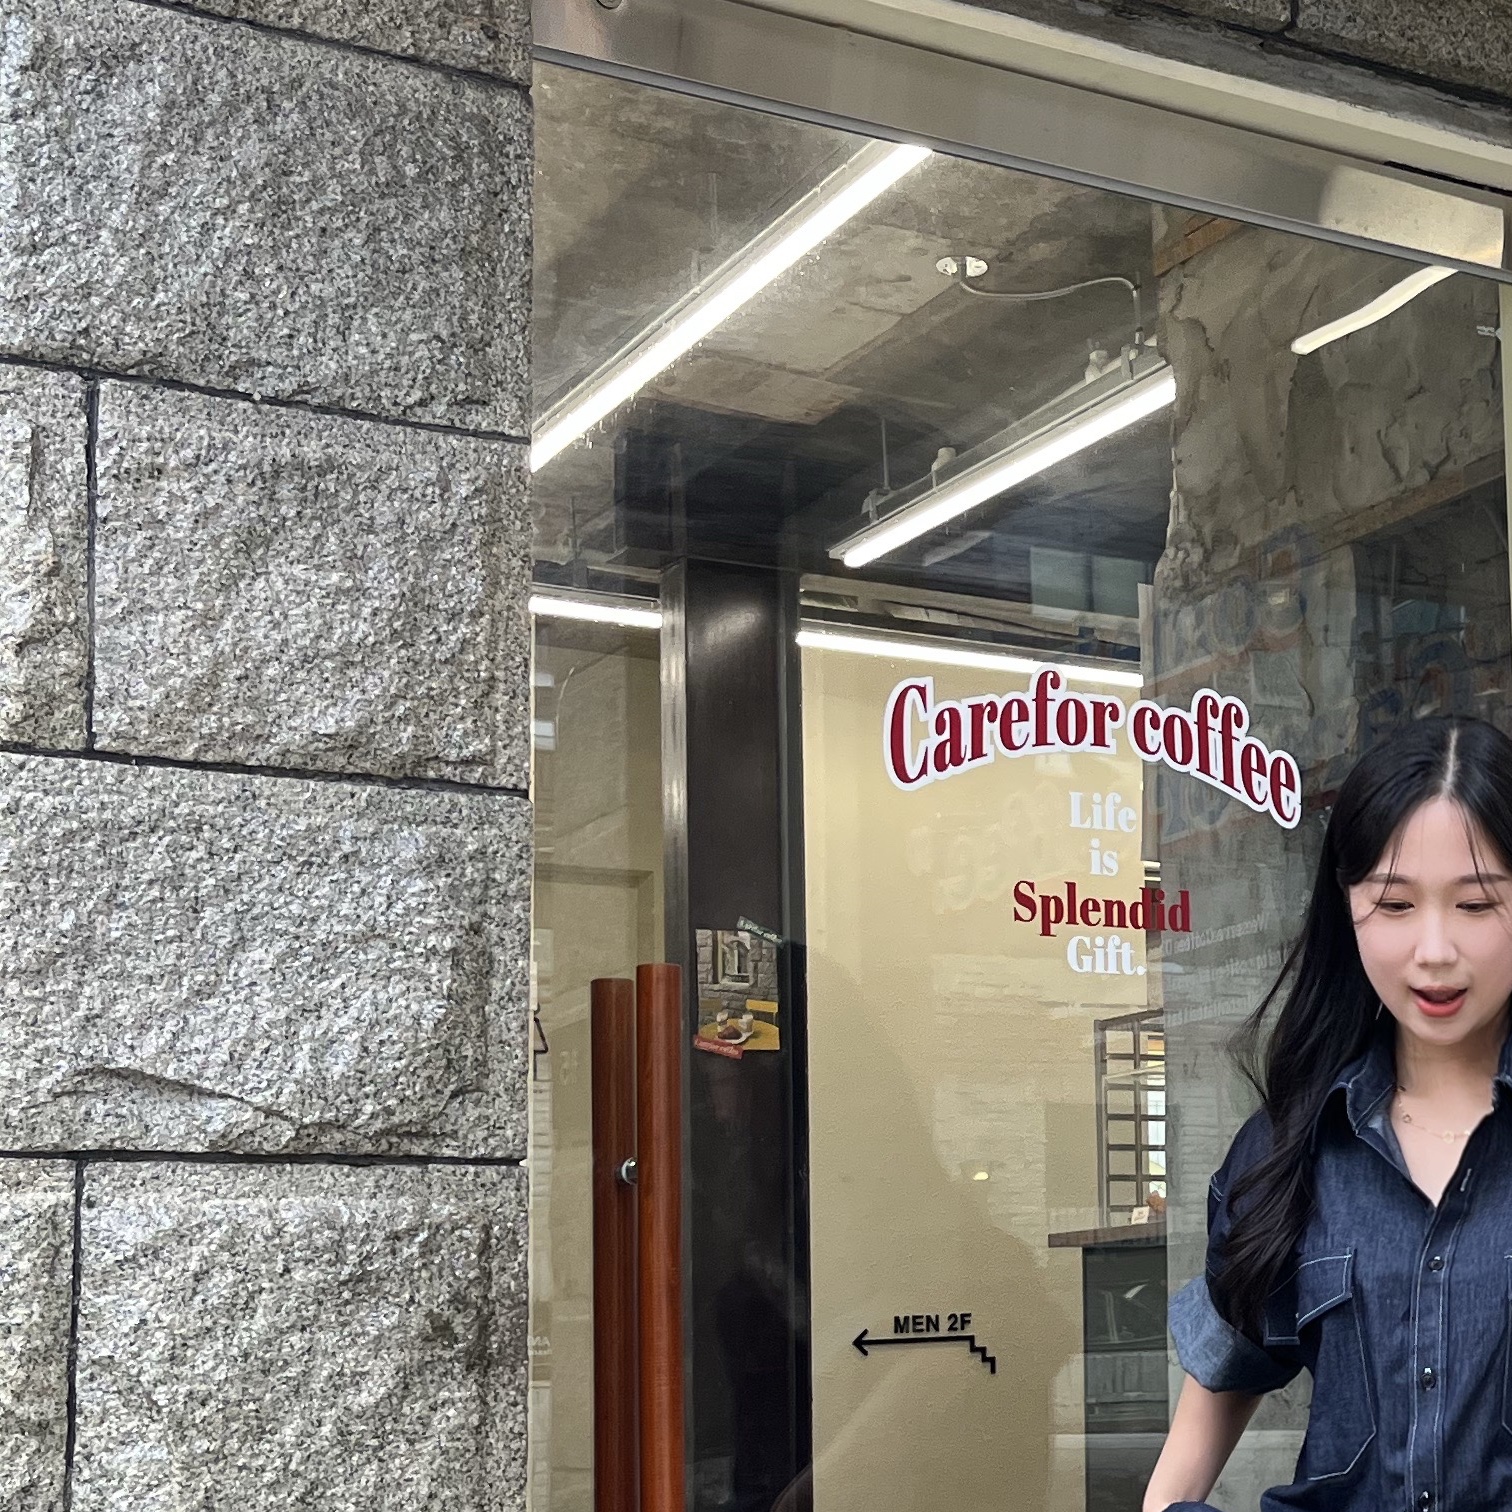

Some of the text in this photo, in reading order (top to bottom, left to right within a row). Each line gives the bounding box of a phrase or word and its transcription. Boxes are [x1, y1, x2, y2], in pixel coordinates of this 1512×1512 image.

[883, 664, 1302, 829] Carefor coffee
[1068, 791, 1137, 833] Life
[1089, 837, 1119, 877] is
[1012, 879, 1192, 937] Splendid
[1066, 934, 1148, 977] Gift.
[893, 1312, 972, 1335] MEN 2F
